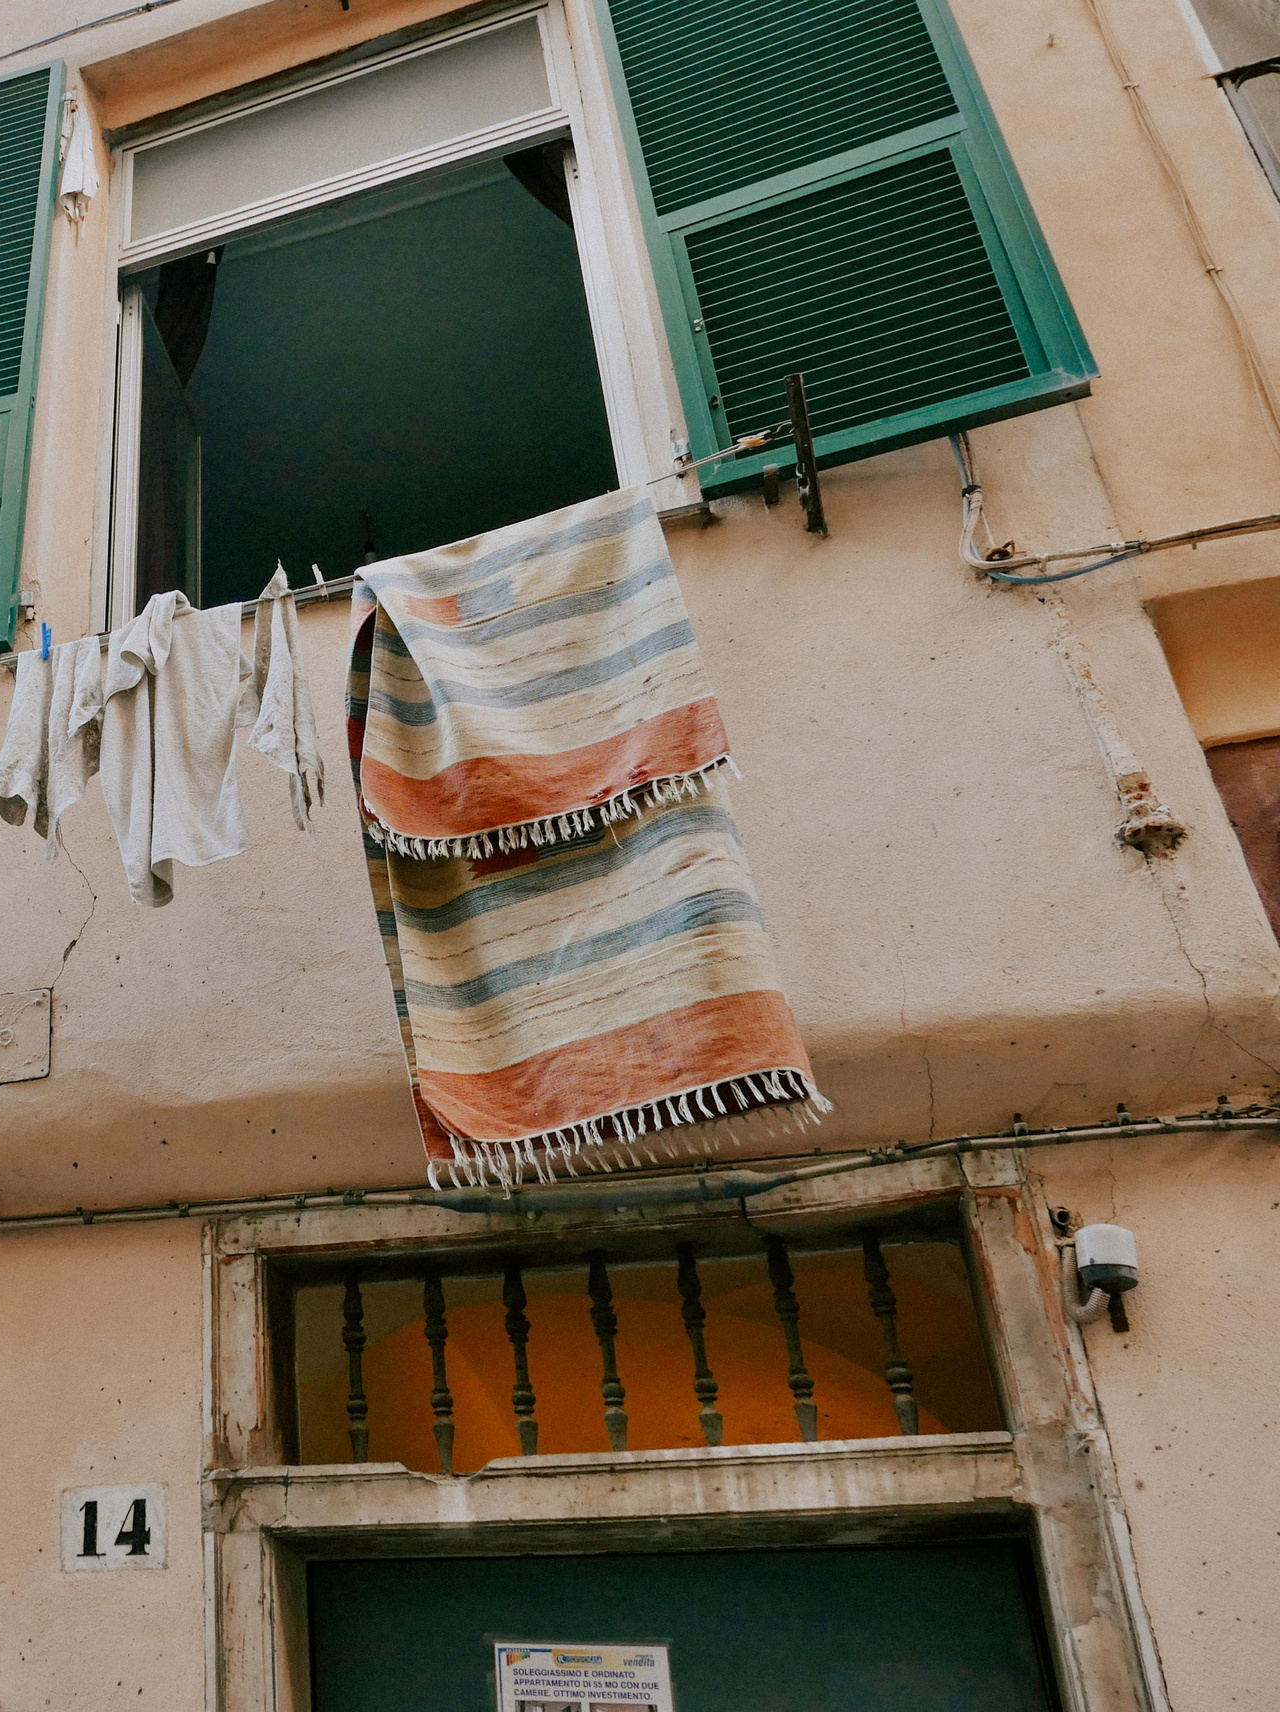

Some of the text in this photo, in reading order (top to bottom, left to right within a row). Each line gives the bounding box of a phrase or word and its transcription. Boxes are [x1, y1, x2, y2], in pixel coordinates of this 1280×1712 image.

[76, 1498, 151, 1557] 14
[623, 1657, 655, 1667] vendita
[513, 1669, 636, 1679] SOLEGGIASSIMO E ORDINATO
[513, 1679, 581, 1688] APPARTAMENTO
[583, 1680, 592, 1688] DI
[592, 1681, 603, 1689] 55
[620, 1682, 640, 1690] CON
[641, 1682, 660, 1690] DUE
[553, 1690, 586, 1699] OTTIMO
